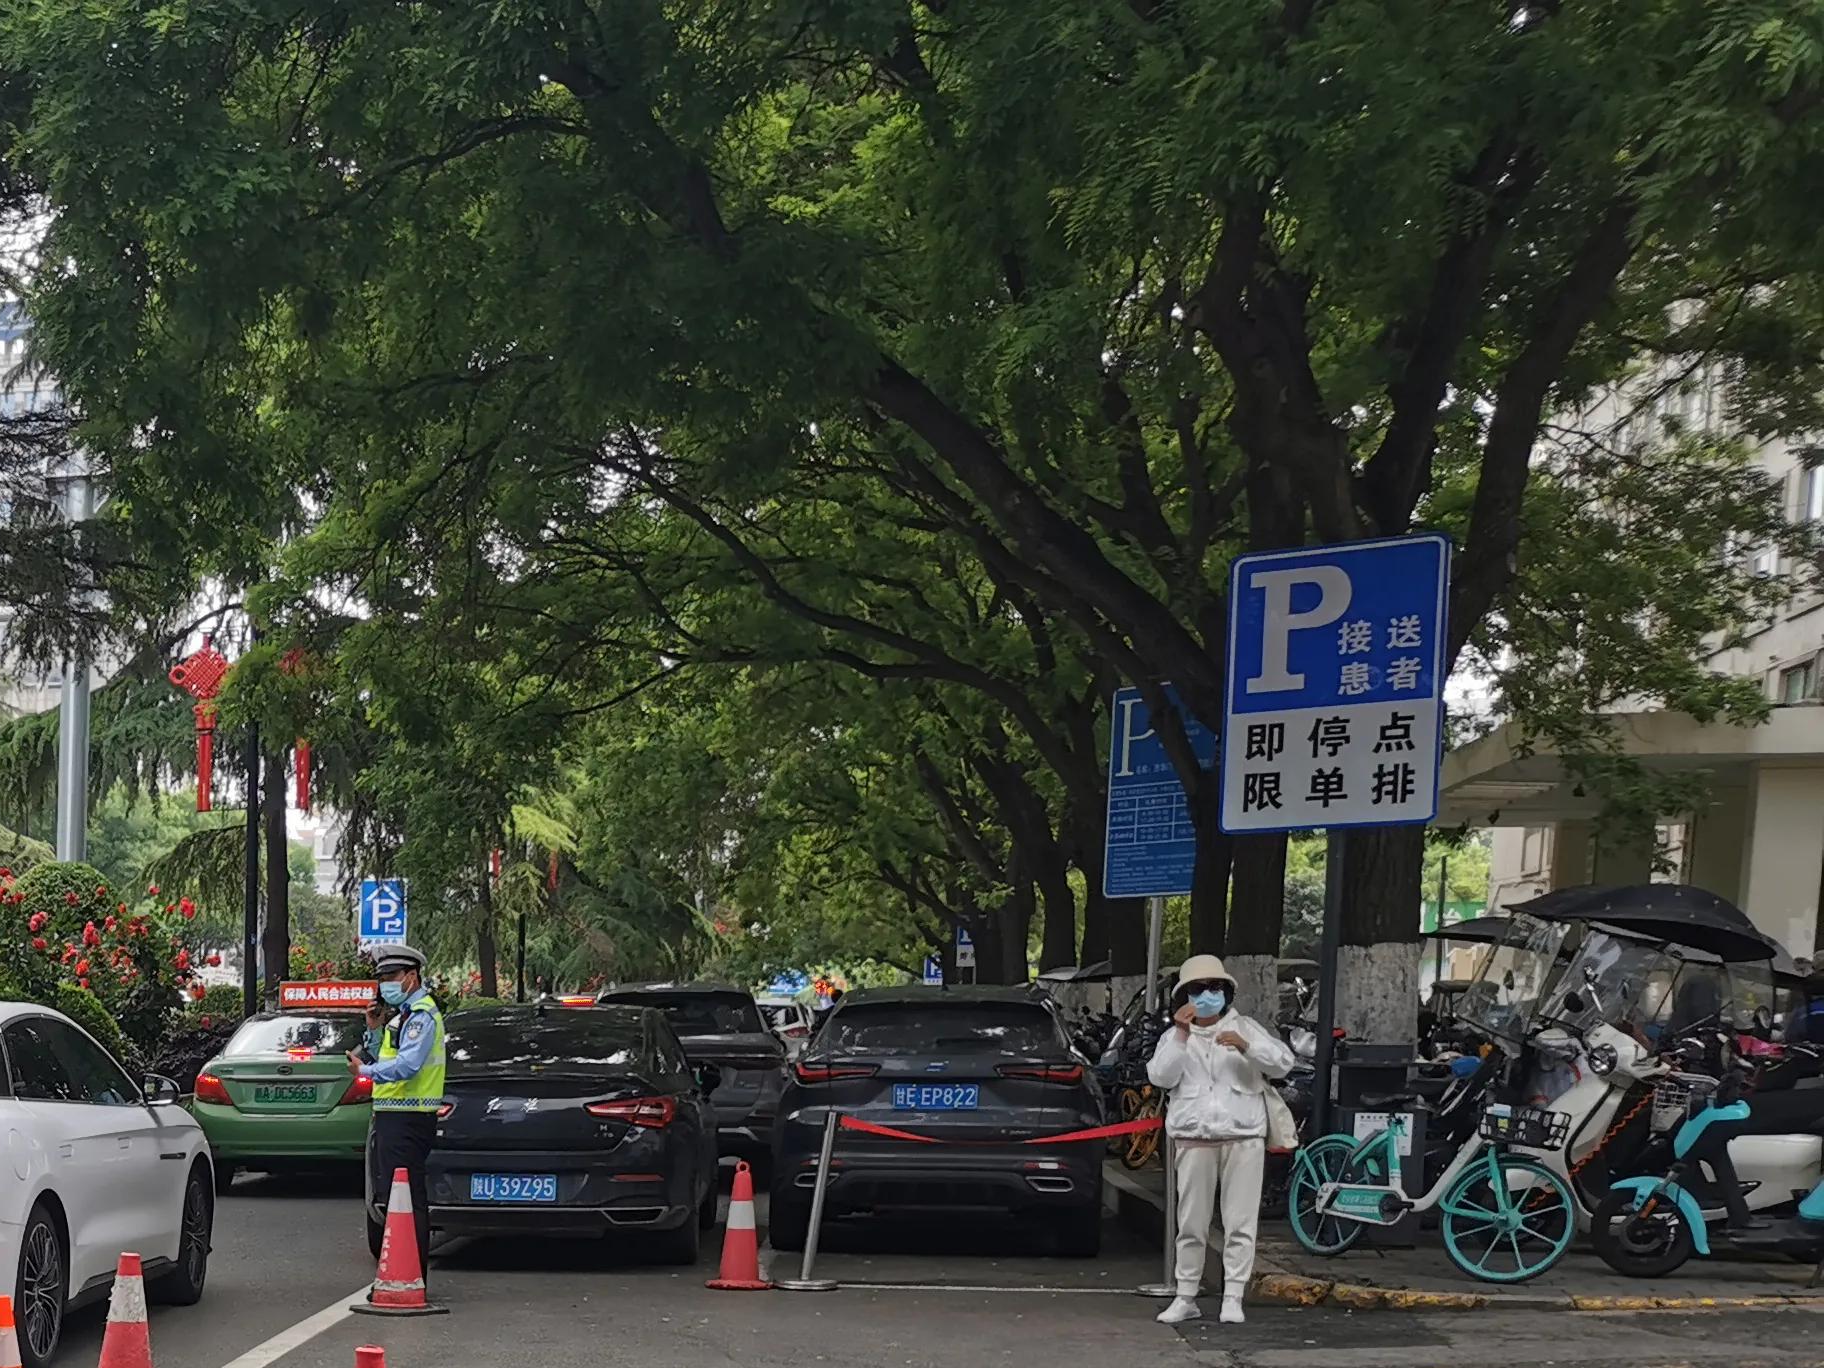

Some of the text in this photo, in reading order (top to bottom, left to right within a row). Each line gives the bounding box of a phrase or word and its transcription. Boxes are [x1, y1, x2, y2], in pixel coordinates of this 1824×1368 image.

[1246, 565, 1353, 695] P
[1338, 614, 1422, 656] 接送
[1337, 656, 1422, 697] 患者
[1244, 711, 1417, 763] 即停点
[1242, 763, 1416, 813] 限单排
[371, 898, 398, 930] P
[284, 987, 374, 1001] 保障人民合法权益
